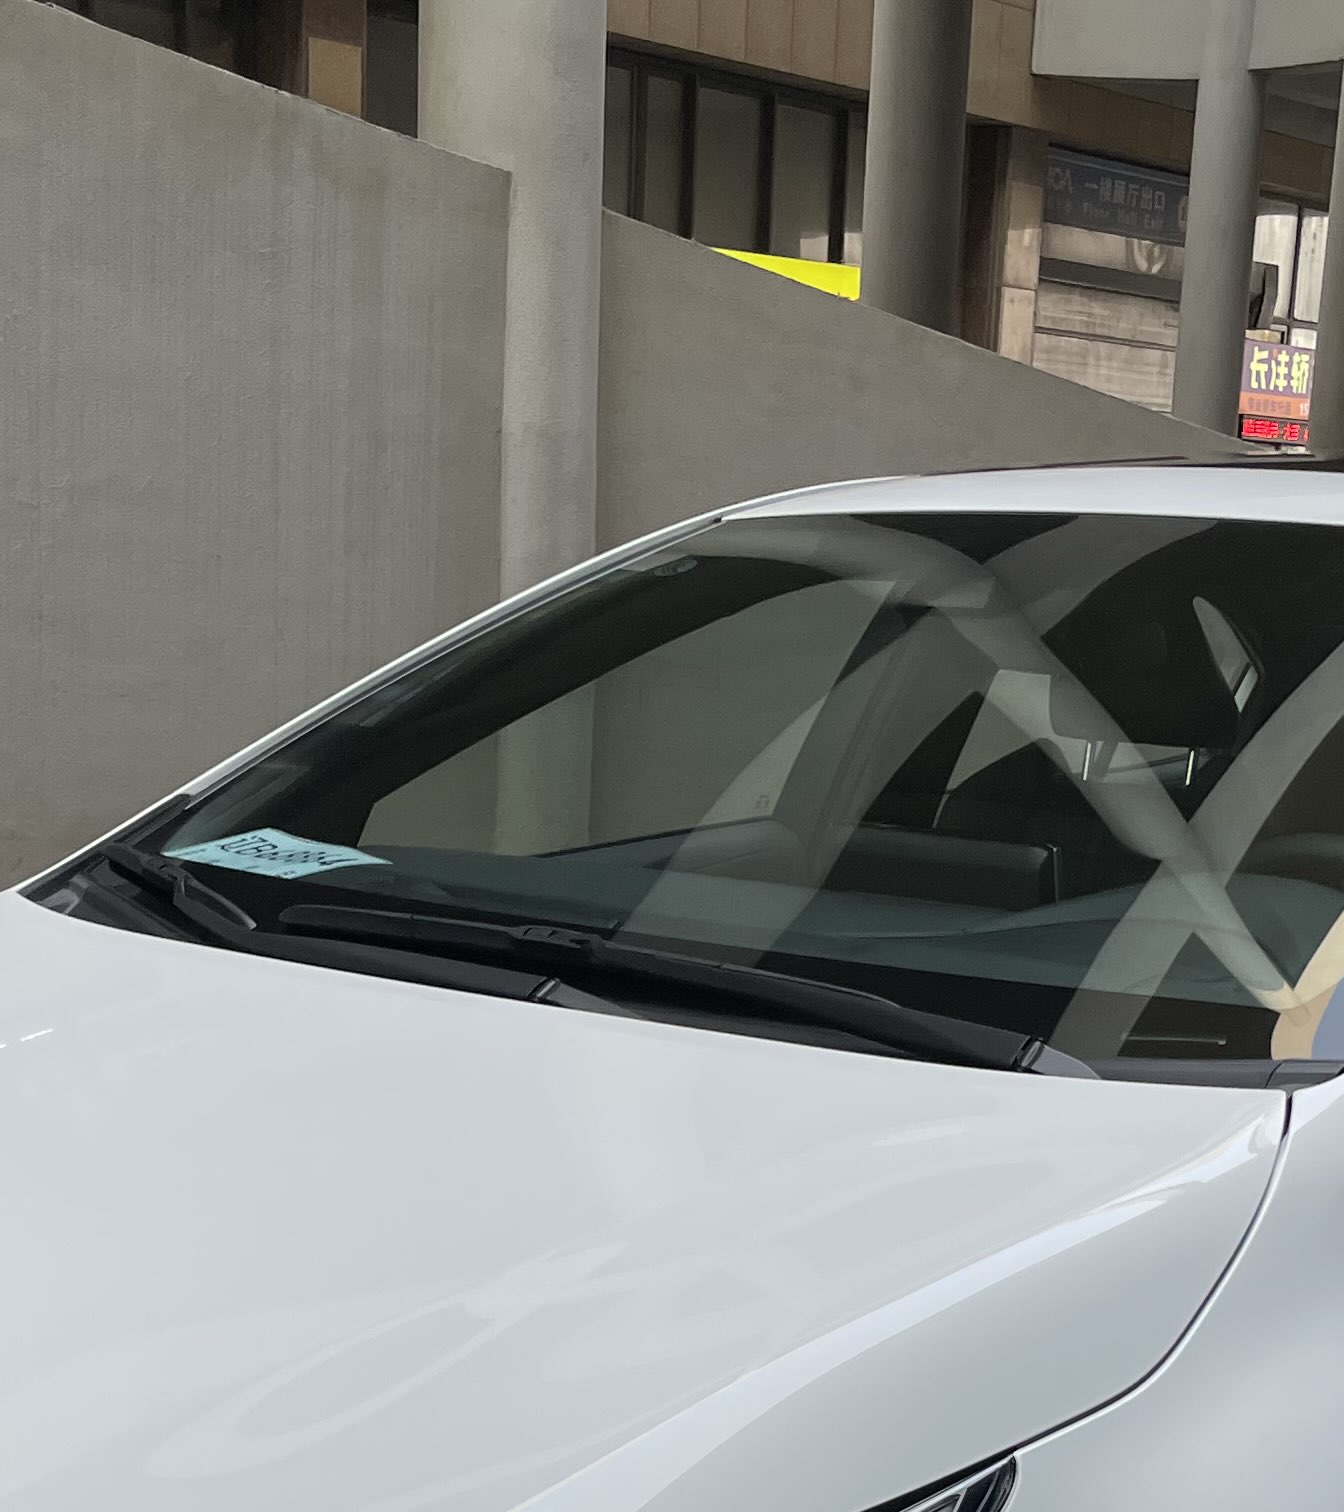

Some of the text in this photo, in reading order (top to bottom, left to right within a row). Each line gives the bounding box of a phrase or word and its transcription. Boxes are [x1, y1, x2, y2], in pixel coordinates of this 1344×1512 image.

[1084, 176, 1165, 210] 一楼展厅出口
